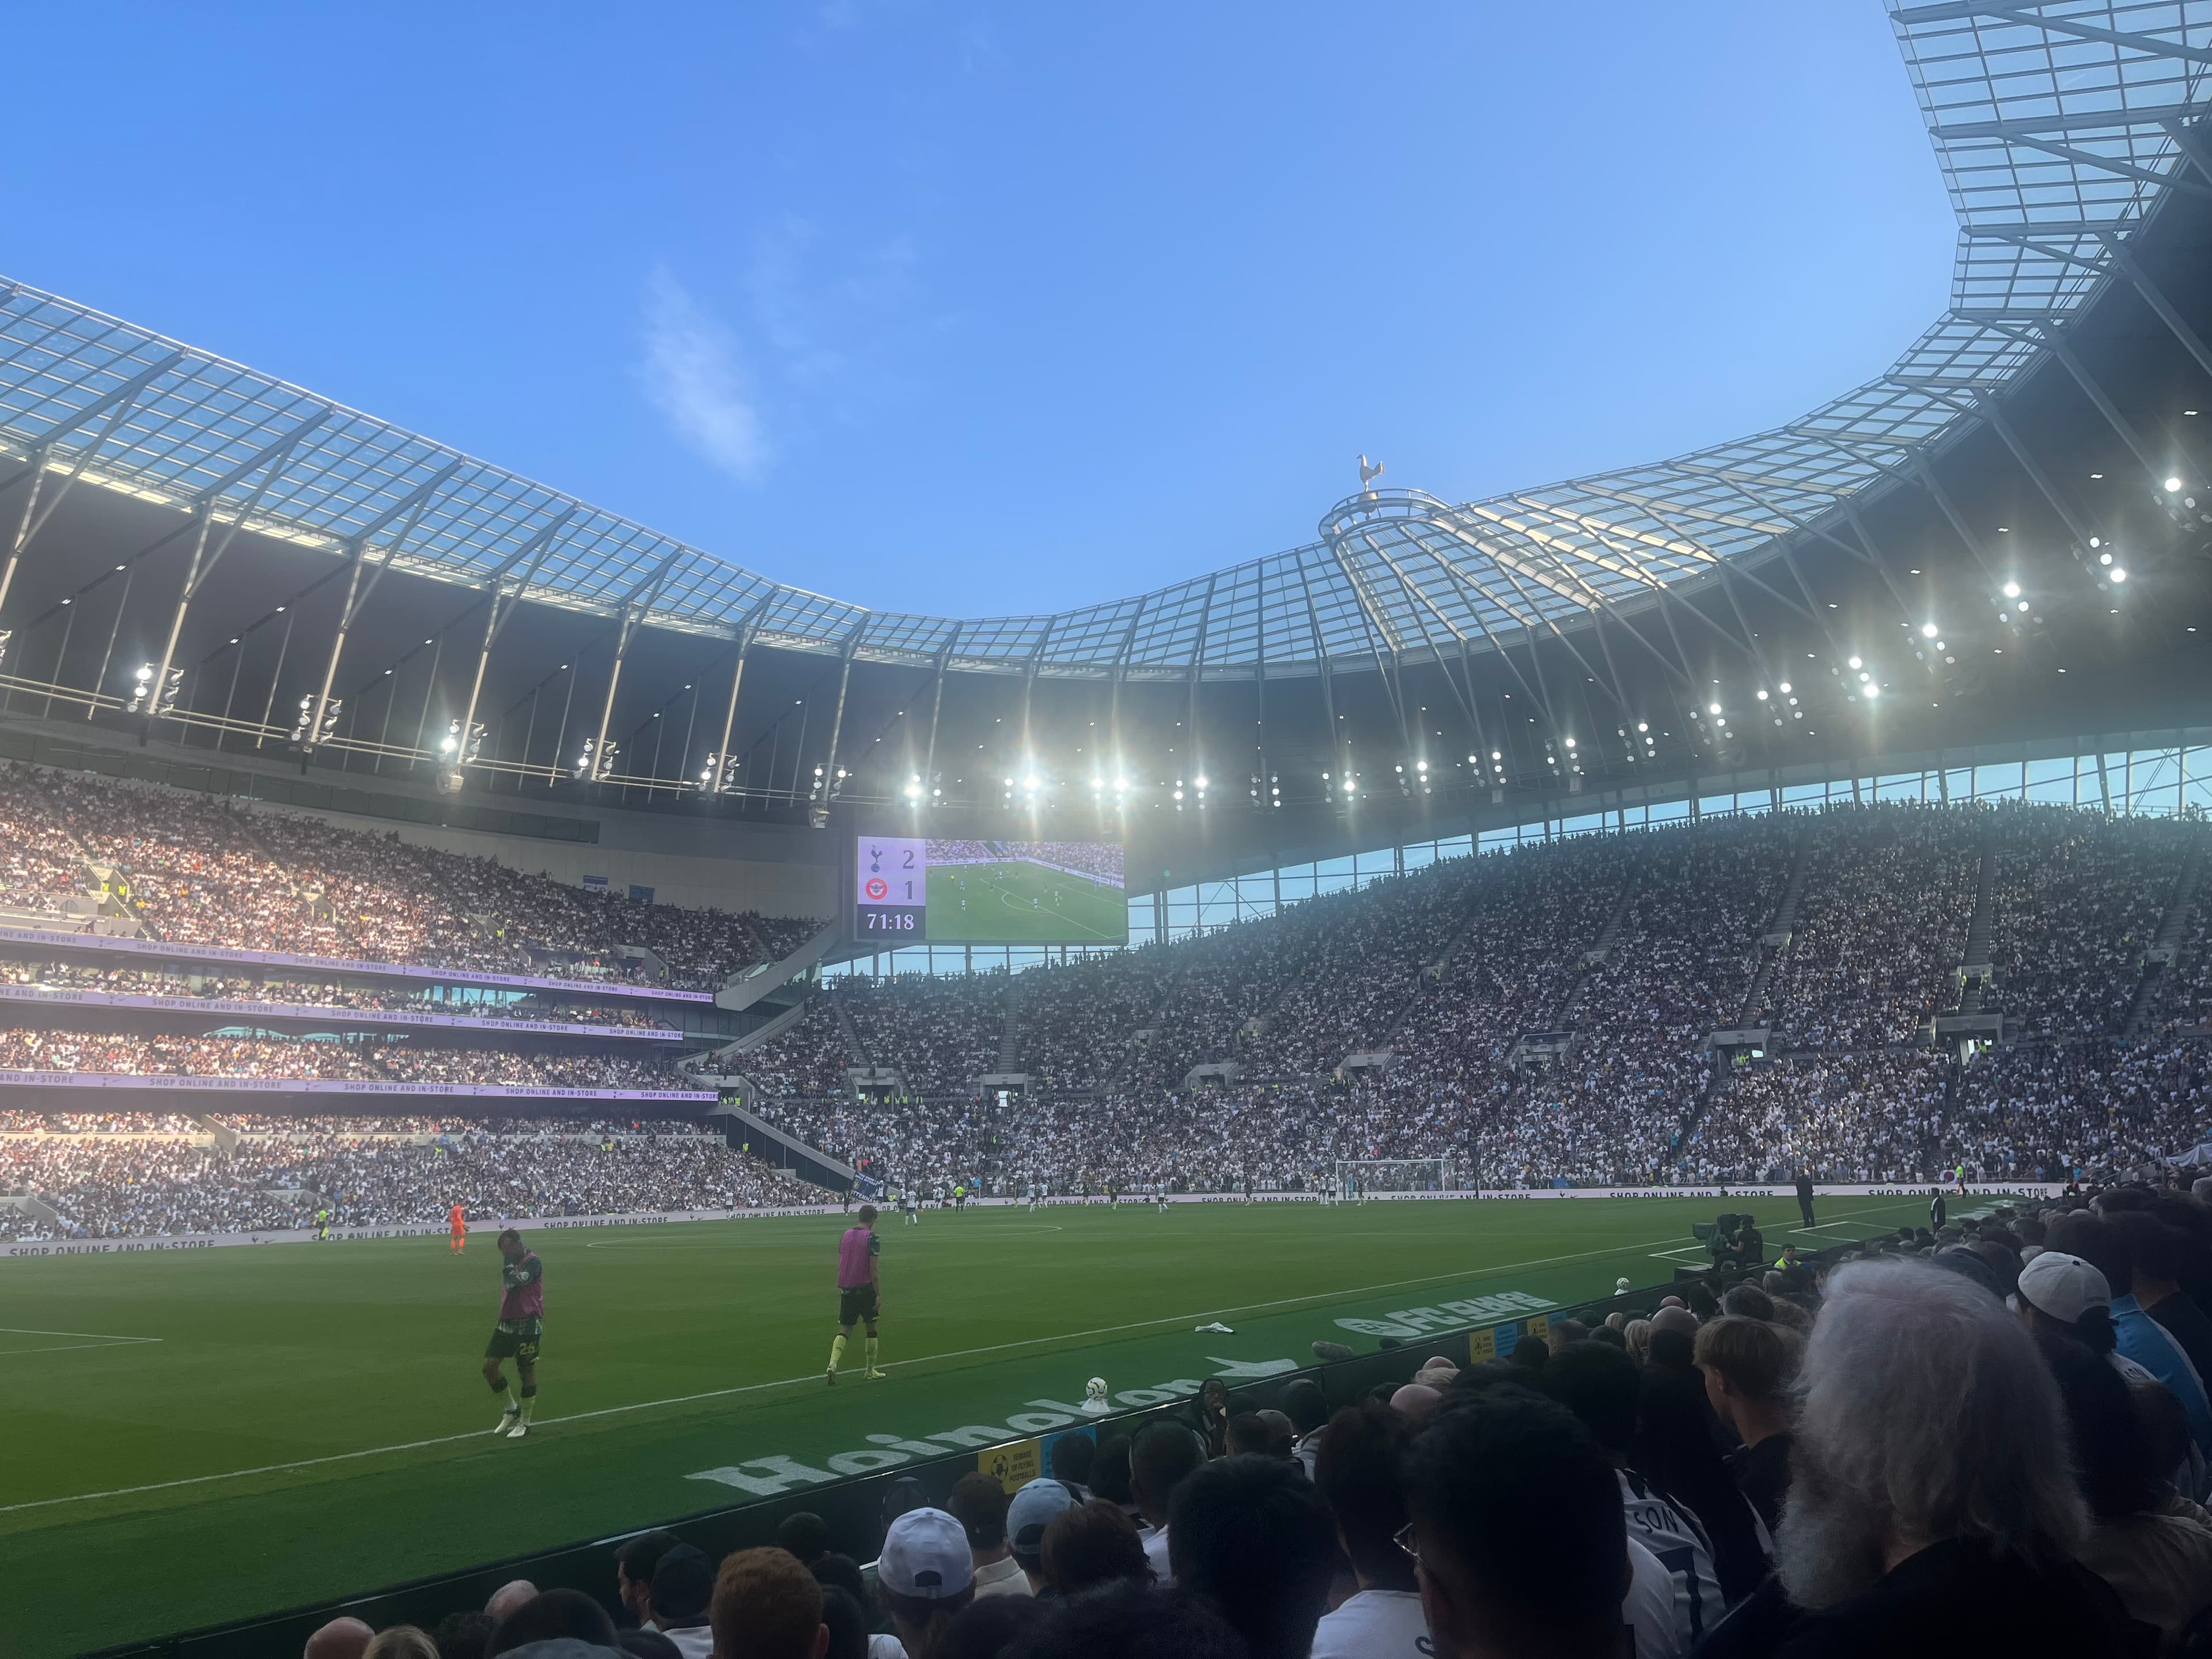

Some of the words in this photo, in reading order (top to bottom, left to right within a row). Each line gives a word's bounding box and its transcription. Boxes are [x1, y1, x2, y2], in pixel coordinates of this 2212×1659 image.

[903, 850, 915, 869] 2
[904, 881, 913, 899] 1
[867, 913, 915, 930] 71:18
[37, 934, 77, 944] IN-STORE
[161, 946, 189, 954] ONLINE
[209, 950, 243, 959] IN-STORE
[38, 991, 84, 1001] IN-STORE
[179, 1000, 211, 1009] ONLINE
[235, 1005, 274, 1013] IN-STORE
[354, 1012, 381, 1020] ONLINE
[400, 1014, 433, 1023] IN-STORE
[0, 1074, 21, 1082] AND
[24, 1074, 74, 1084] IN-STORE
[149, 1078, 176, 1086] SHOP
[179, 1079, 214, 1087] ONLINE
[240, 1081, 282, 1089] IN-STORE
[9, 1248, 50, 1256] SHOP
[115, 1243, 144, 1252] AND
[150, 1240, 215, 1251] IN-STORE
[1384, 1306, 1469, 1331] FC
[1013, 1449, 1033, 1461] BEWARE
[1011, 1464, 1018, 1472] OF
[1018, 1460, 1035, 1471] FLYING
[1009, 1469, 1036, 1483] FOOTBALLS
[1634, 1506, 1679, 1535] SON
